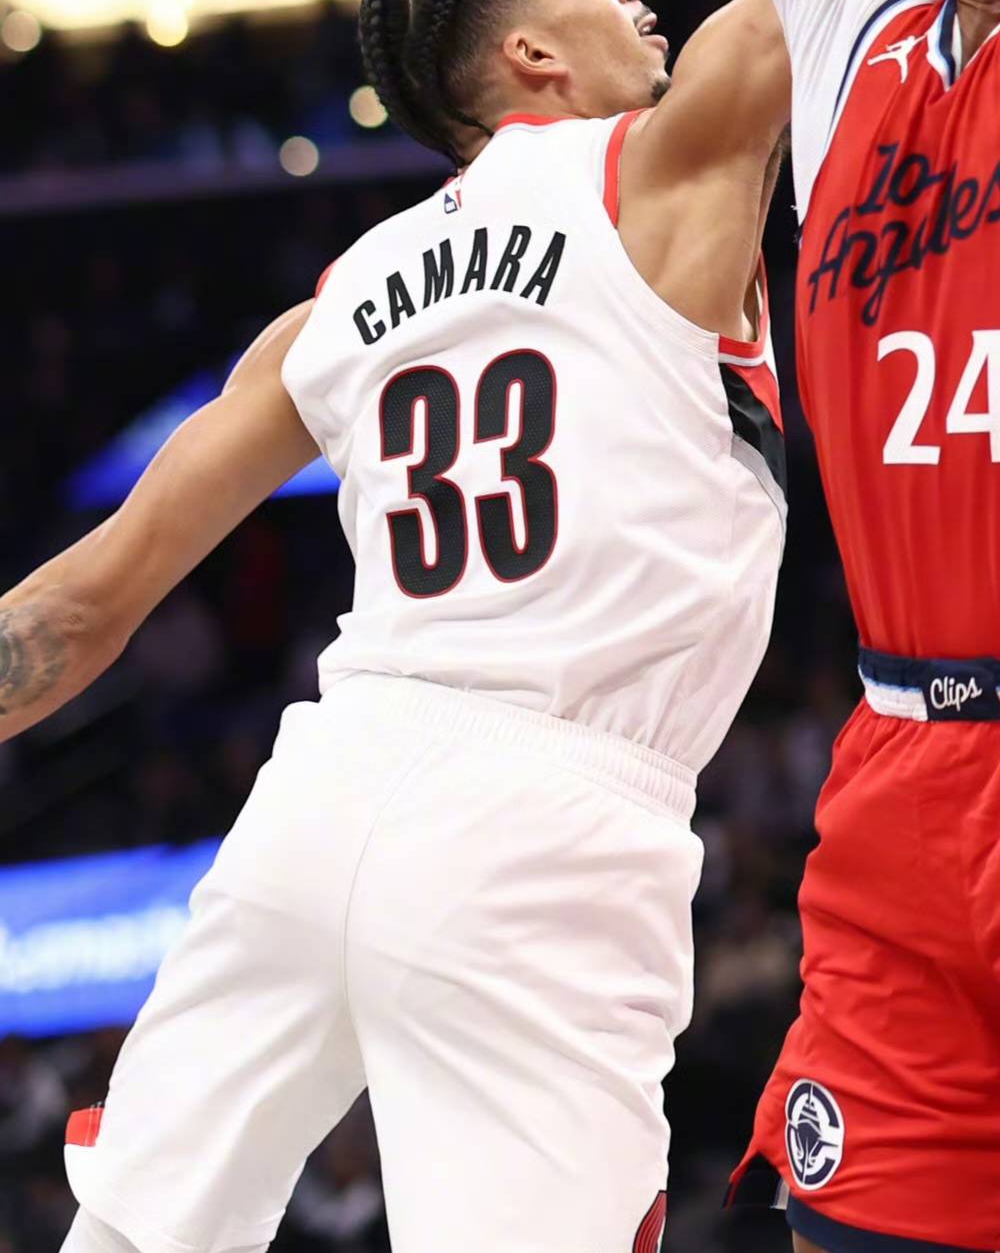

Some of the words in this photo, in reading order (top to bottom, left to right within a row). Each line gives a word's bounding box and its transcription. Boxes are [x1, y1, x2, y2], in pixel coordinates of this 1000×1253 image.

[352, 224, 568, 346] CAMARA
[378, 347, 559, 600] 33
[929, 675, 983, 712] Clips
